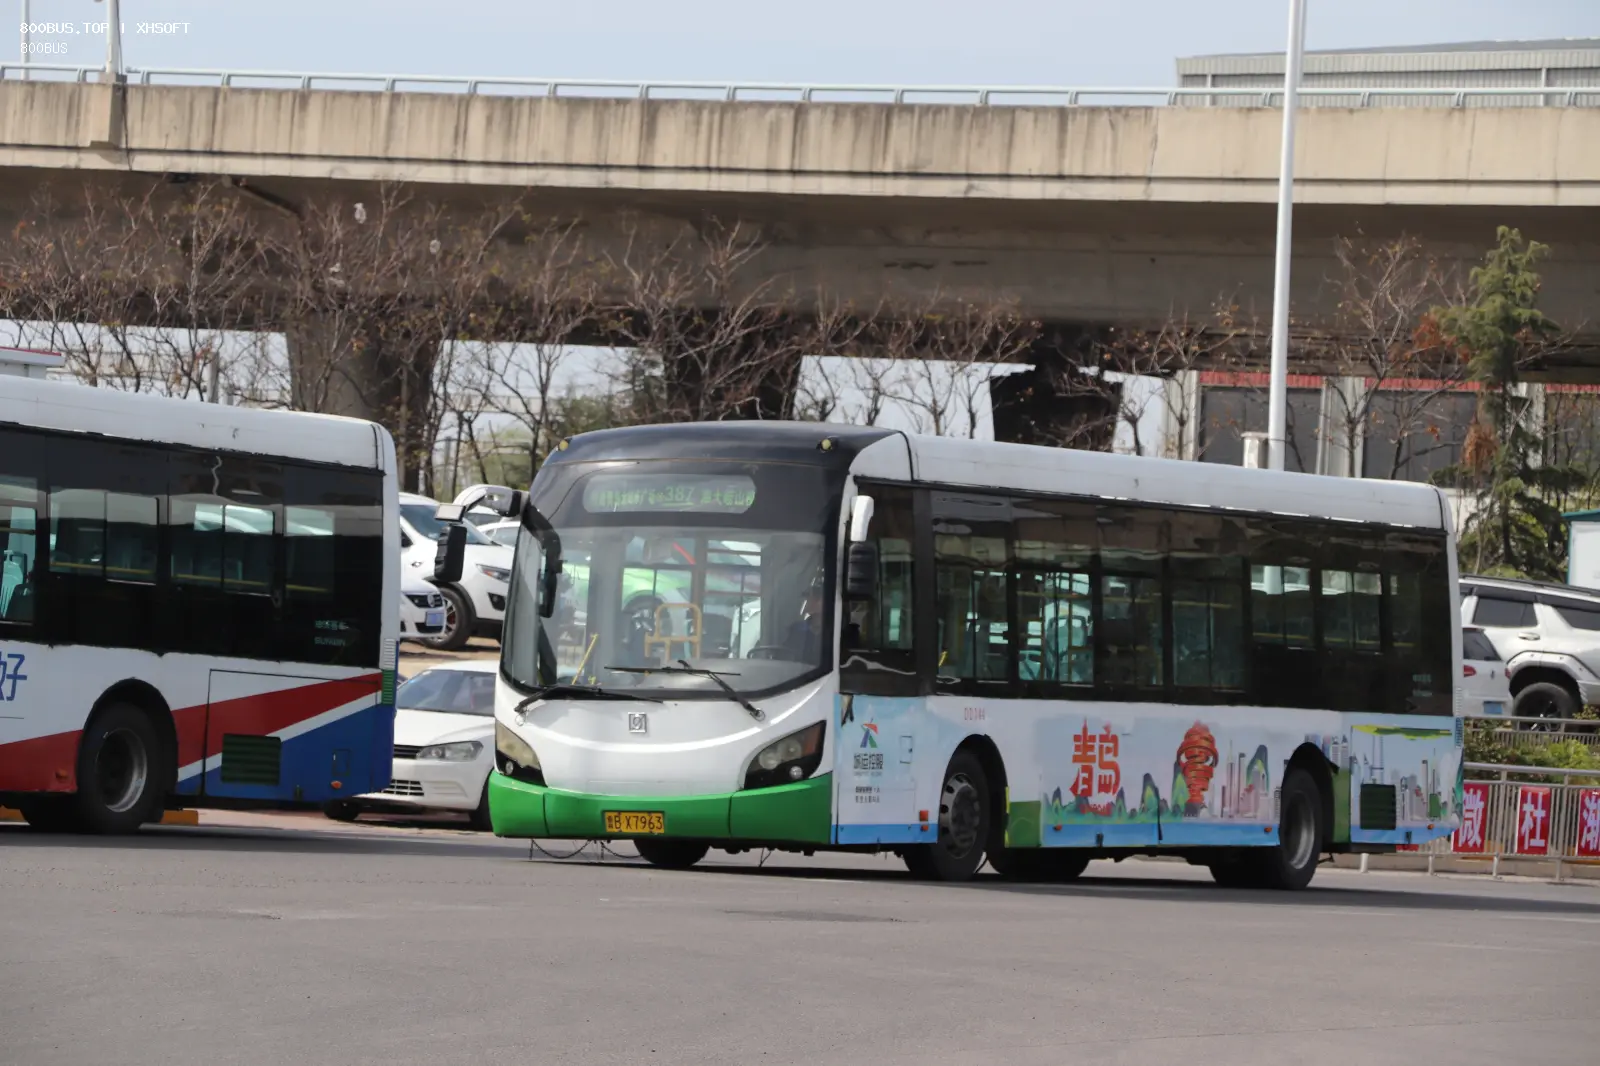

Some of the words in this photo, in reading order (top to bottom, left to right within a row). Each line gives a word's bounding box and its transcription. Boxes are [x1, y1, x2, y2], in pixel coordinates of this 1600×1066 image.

[665, 486, 696, 502] 387
[1458, 788, 1485, 848] 微
[1520, 792, 1547, 851] 杜
